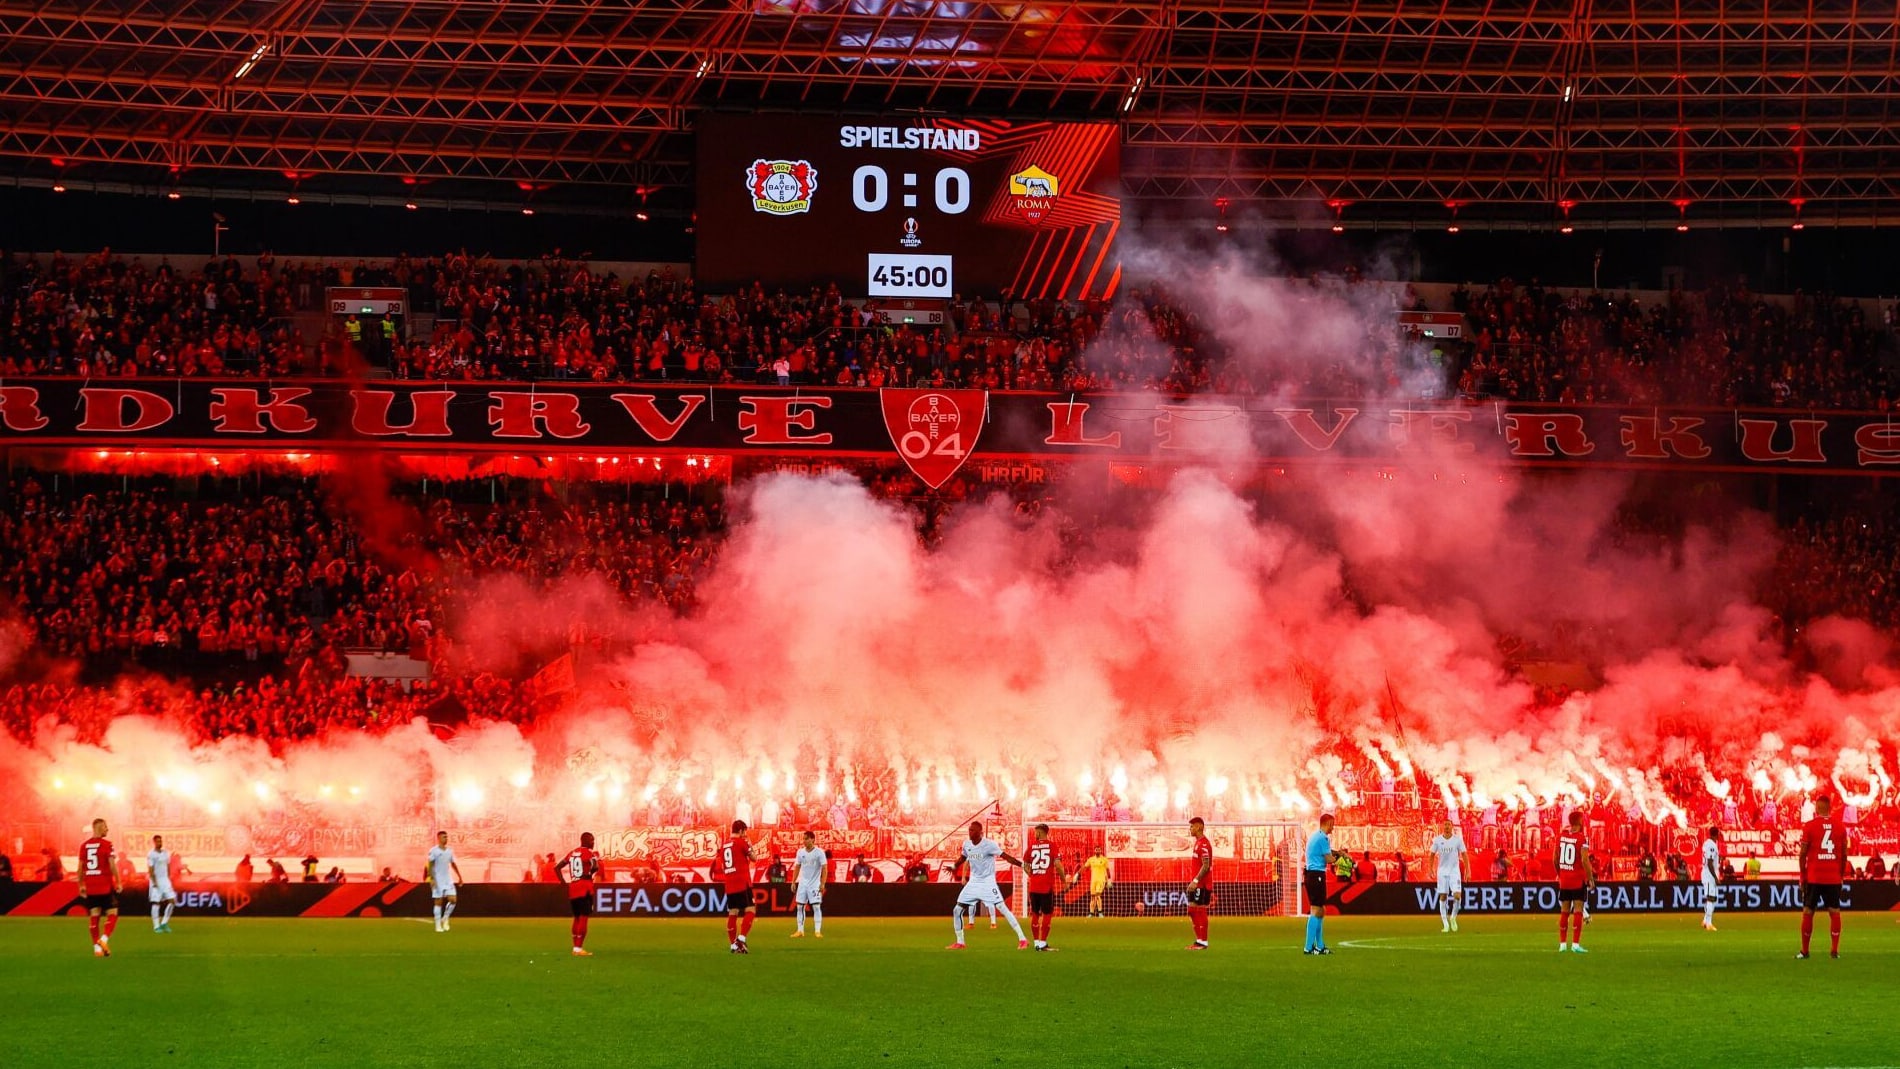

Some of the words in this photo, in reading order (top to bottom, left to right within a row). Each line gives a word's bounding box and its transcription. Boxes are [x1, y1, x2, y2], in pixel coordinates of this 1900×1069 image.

[840, 126, 980, 151] SPIELSTAND
[759, 200, 804, 211] Leverkusen
[1017, 199, 1051, 209] ROMA
[873, 265, 947, 288] 45:00
[1447, 326, 1460, 337] D7
[911, 413, 958, 422] BAYER
[928, 397, 939, 440] BAYER
[900, 430, 966, 460] 04
[982, 466, 1010, 482] IHR
[1012, 463, 1045, 482] FÜR
[1243, 826, 1270, 837] WEST
[1720, 830, 1772, 843] YOUNG
[124, 834, 224, 852] CRSSFIRE
[681, 831, 719, 859] S13
[1243, 836, 1270, 849] SIDE
[1821, 830, 1835, 854] 4
[86, 848, 98, 870] 5
[723, 847, 733, 868] 9
[1030, 848, 1051, 870] 25
[1243, 848, 1270, 860] BOYZ
[1560, 842, 1576, 865] 10
[569, 856, 583, 878] 19
[174, 891, 223, 908] UEFA
[596, 888, 730, 912] EFA.COM
[752, 888, 826, 912] PLA
[992, 888, 998, 896] 9
[1144, 891, 1190, 907] UEFA
[1415, 886, 1514, 911] WERE
[1522, 885, 1664, 910] FOBALL
[1769, 884, 1852, 909] MUC
